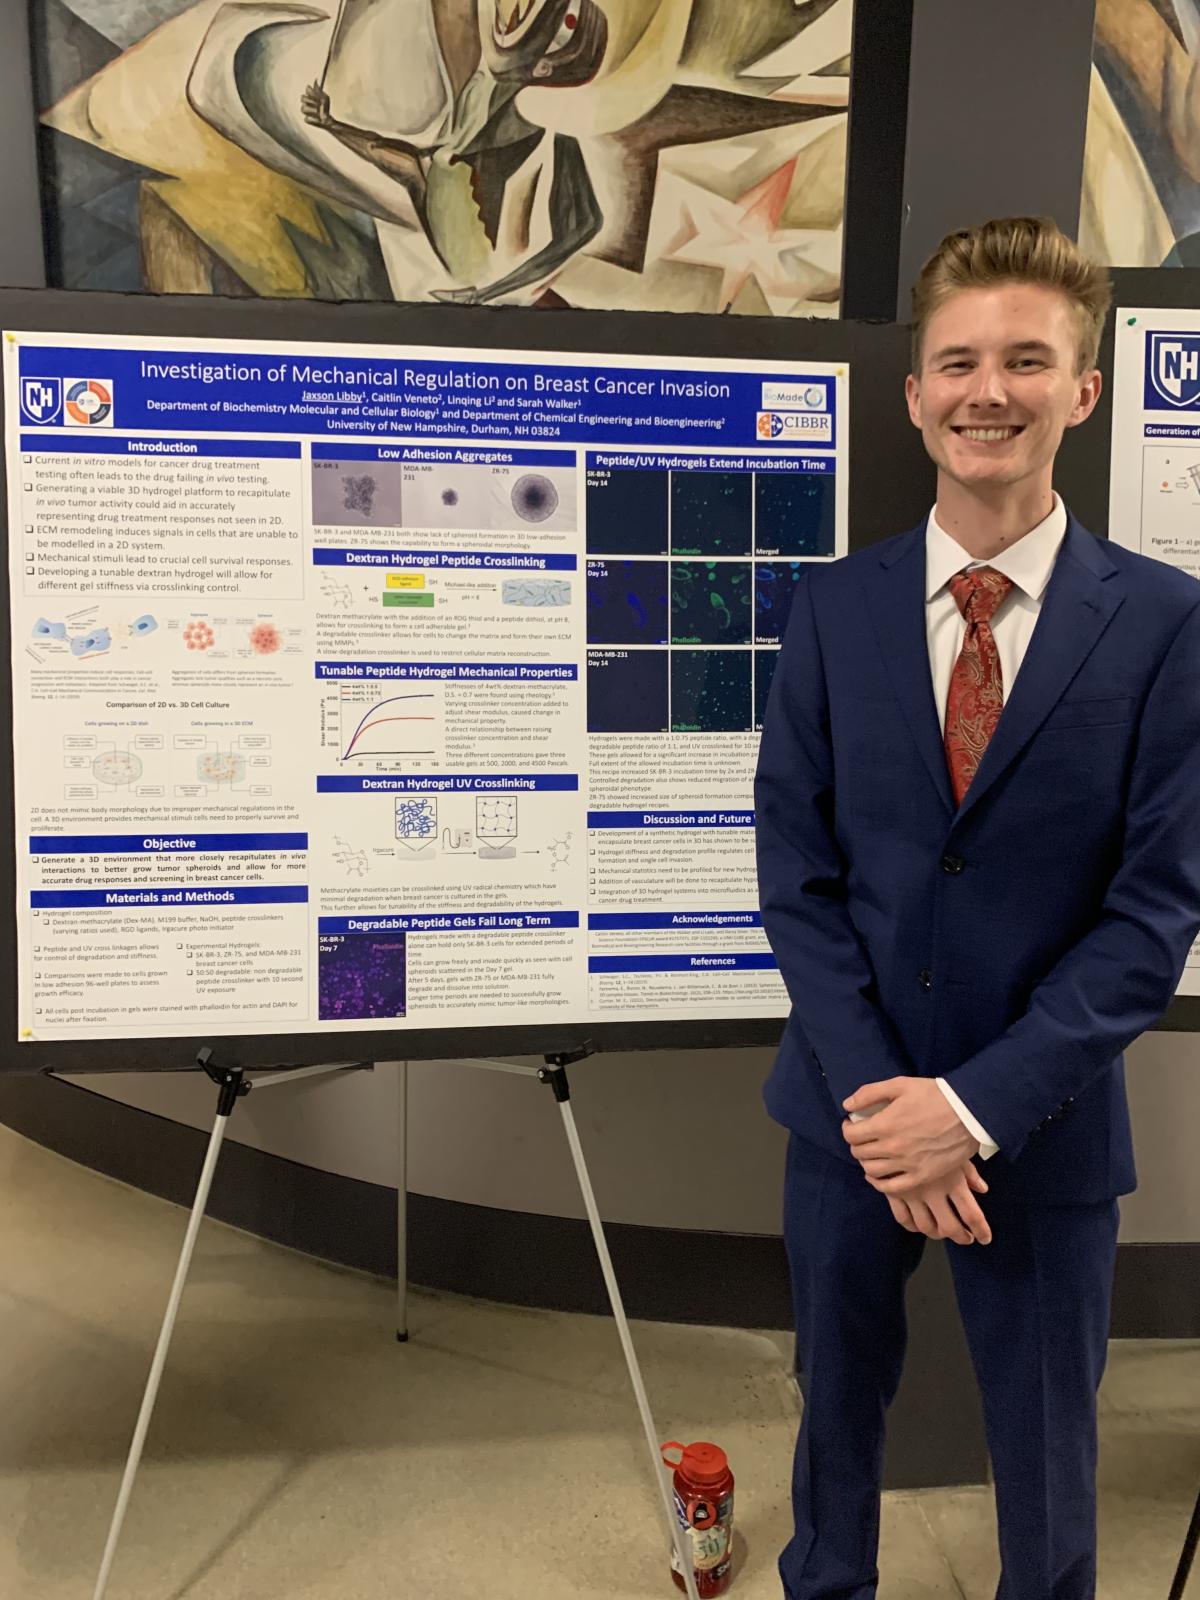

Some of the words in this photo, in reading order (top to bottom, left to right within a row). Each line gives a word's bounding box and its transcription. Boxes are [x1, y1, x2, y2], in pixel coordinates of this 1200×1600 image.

[1164, 350, 1198, 380] NH
[141, 361, 260, 383] Investigation
[267, 364, 286, 381] of
[292, 366, 397, 385] Mechanical
[404, 369, 499, 391] Regulation
[505, 377, 527, 390] on
[534, 374, 589, 392] Breast
[594, 377, 654, 394] Cancer
[660, 380, 729, 397] Invasion
[29, 387, 53, 408] NH
[300, 391, 335, 403] Jaxson
[370, 392, 403, 403] Caitlin
[445, 395, 482, 407] Linqing
[497, 397, 515, 408] and
[515, 397, 545, 409] Sarah
[146, 399, 207, 411] Department
[209, 401, 221, 411] of
[223, 402, 287, 414] Biochemistry
[289, 404, 338, 414] Molecular
[341, 406, 359, 415] and
[361, 406, 398, 416] Cellular
[442, 409, 460, 418] and
[462, 409, 519, 420] Department
[521, 411, 531, 421] of
[533, 412, 576, 422] Chemical
[578, 414, 632, 426] Engineering
[634, 416, 651, 425] and
[327, 419, 375, 431] University
[377, 420, 388, 430] of
[390, 421, 412, 431] New
[414, 422, 468, 433] Hampshire,
[471, 423, 511, 435] Durham,
[514, 425, 528, 434] NH
[531, 426, 560, 436] 03824
[784, 416, 829, 429] CIBBR
[1145, 426, 1190, 436] Generation
[128, 441, 198, 453] Introduction
[378, 448, 401, 459] Low
[402, 449, 452, 460] Adhesion
[454, 450, 513, 463] Aggregates
[596, 455, 655, 467] Peptide/UV
[657, 457, 707, 469] Hydrogels
[709, 458, 743, 468] Extend
[746, 459, 799, 469] Incubation
[801, 459, 825, 469] Time
[35, 455, 70, 464] Current
[107, 458, 141, 467] models
[143, 458, 156, 467] for
[191, 460, 212, 470] drug
[214, 461, 259, 469] treatment
[35, 470, 67, 480] testing
[69, 470, 94, 479] often
[96, 471, 121, 480] leads
[135, 472, 150, 481] the
[153, 473, 174, 483] drug
[176, 473, 204, 483] failing
[587, 479, 599, 488] Day
[599, 479, 608, 487] 14
[755, 548, 779, 556] Merged
[346, 553, 389, 564] Dextran
[391, 554, 439, 566] Hydrogel
[441, 555, 481, 568] Peptide
[483, 555, 546, 569] Crosslinking
[587, 570, 599, 578] Day
[38, 580, 77, 589] different
[79, 581, 93, 591] gel
[96, 581, 134, 590] stiffness
[151, 583, 204, 593] crosslinking
[755, 636, 779, 644] Merged
[320, 665, 363, 675] Tunable
[366, 666, 406, 677] Peptide
[409, 666, 455, 678] Hydrogel
[458, 667, 517, 676] Mechanical
[520, 667, 573, 678] Properties
[362, 779, 404, 788] Dextran
[407, 778, 453, 790] Hydrogel
[456, 778, 472, 788] UV
[474, 778, 535, 791] Crosslinking
[643, 814, 695, 824] Discussion
[697, 814, 716, 823] and
[718, 814, 751, 823] Future
[143, 838, 196, 850] Objective
[74, 876, 92, 884] drug
[106, 892, 158, 903] Materials
[161, 891, 182, 902] and
[185, 891, 234, 901] Methods
[348, 918, 408, 931] Degradable
[411, 917, 451, 929] Peptide
[453, 916, 475, 926] Gels
[478, 916, 495, 926] Fail
[498, 916, 523, 927] Long
[525, 915, 550, 924] Term
[672, 914, 753, 924] Acknowledgements
[319, 944, 332, 953] Day
[332, 944, 338, 952] 7
[690, 957, 735, 965] References
